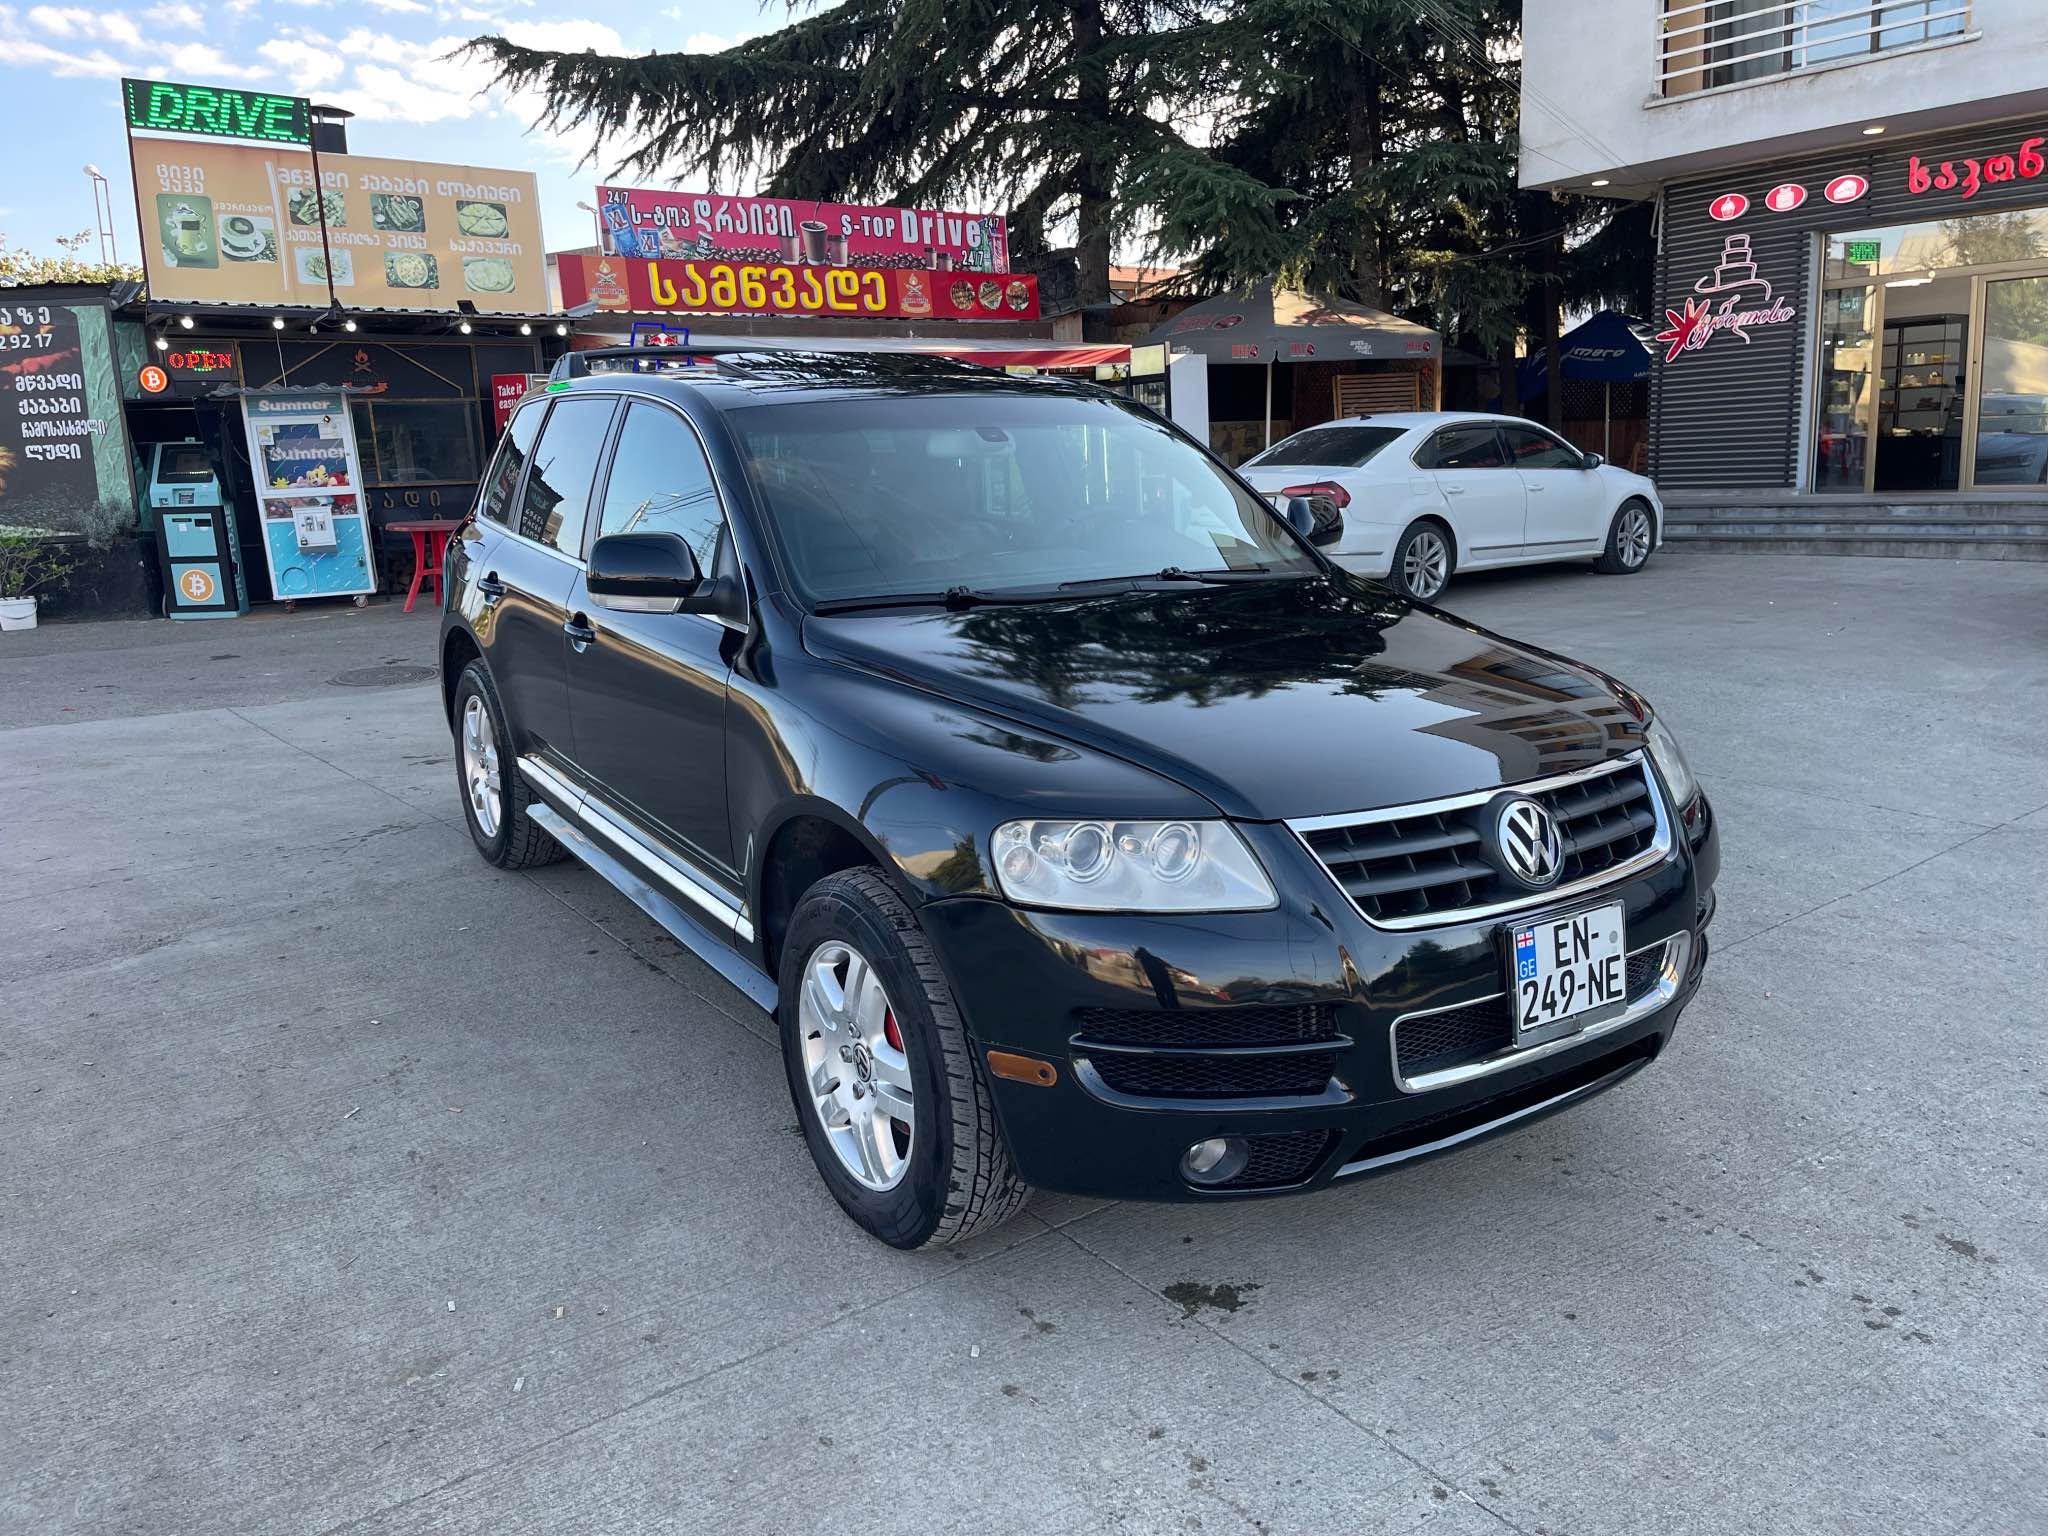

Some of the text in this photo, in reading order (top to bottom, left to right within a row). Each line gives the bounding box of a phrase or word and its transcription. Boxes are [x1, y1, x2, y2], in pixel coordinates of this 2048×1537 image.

[149, 84, 295, 136] DRIVE
[359, 174, 430, 195] ქაბაბი
[436, 180, 521, 202] ლობიანი
[607, 208, 630, 231] XL
[630, 199, 794, 237] ს-ტოპ დრაივი
[841, 209, 981, 247] S-TOP Drive
[640, 234, 658, 252] XL
[961, 250, 984, 267] 24/7
[647, 262, 887, 311] სამწვადე
[168, 353, 232, 369] OPEN
[15, 373, 82, 392] მწვადი
[498, 384, 523, 397] Take it
[18, 397, 82, 415] ქაბაბი
[259, 400, 332, 411] Summer
[21, 419, 108, 439] ჩამოსასხმელი
[24, 443, 82, 461] ლუდი
[270, 447, 345, 461] Summer
[1554, 916, 1599, 969] EN-
[1519, 957, 1536, 978] GE
[1522, 953, 1623, 1026] 249-NE
